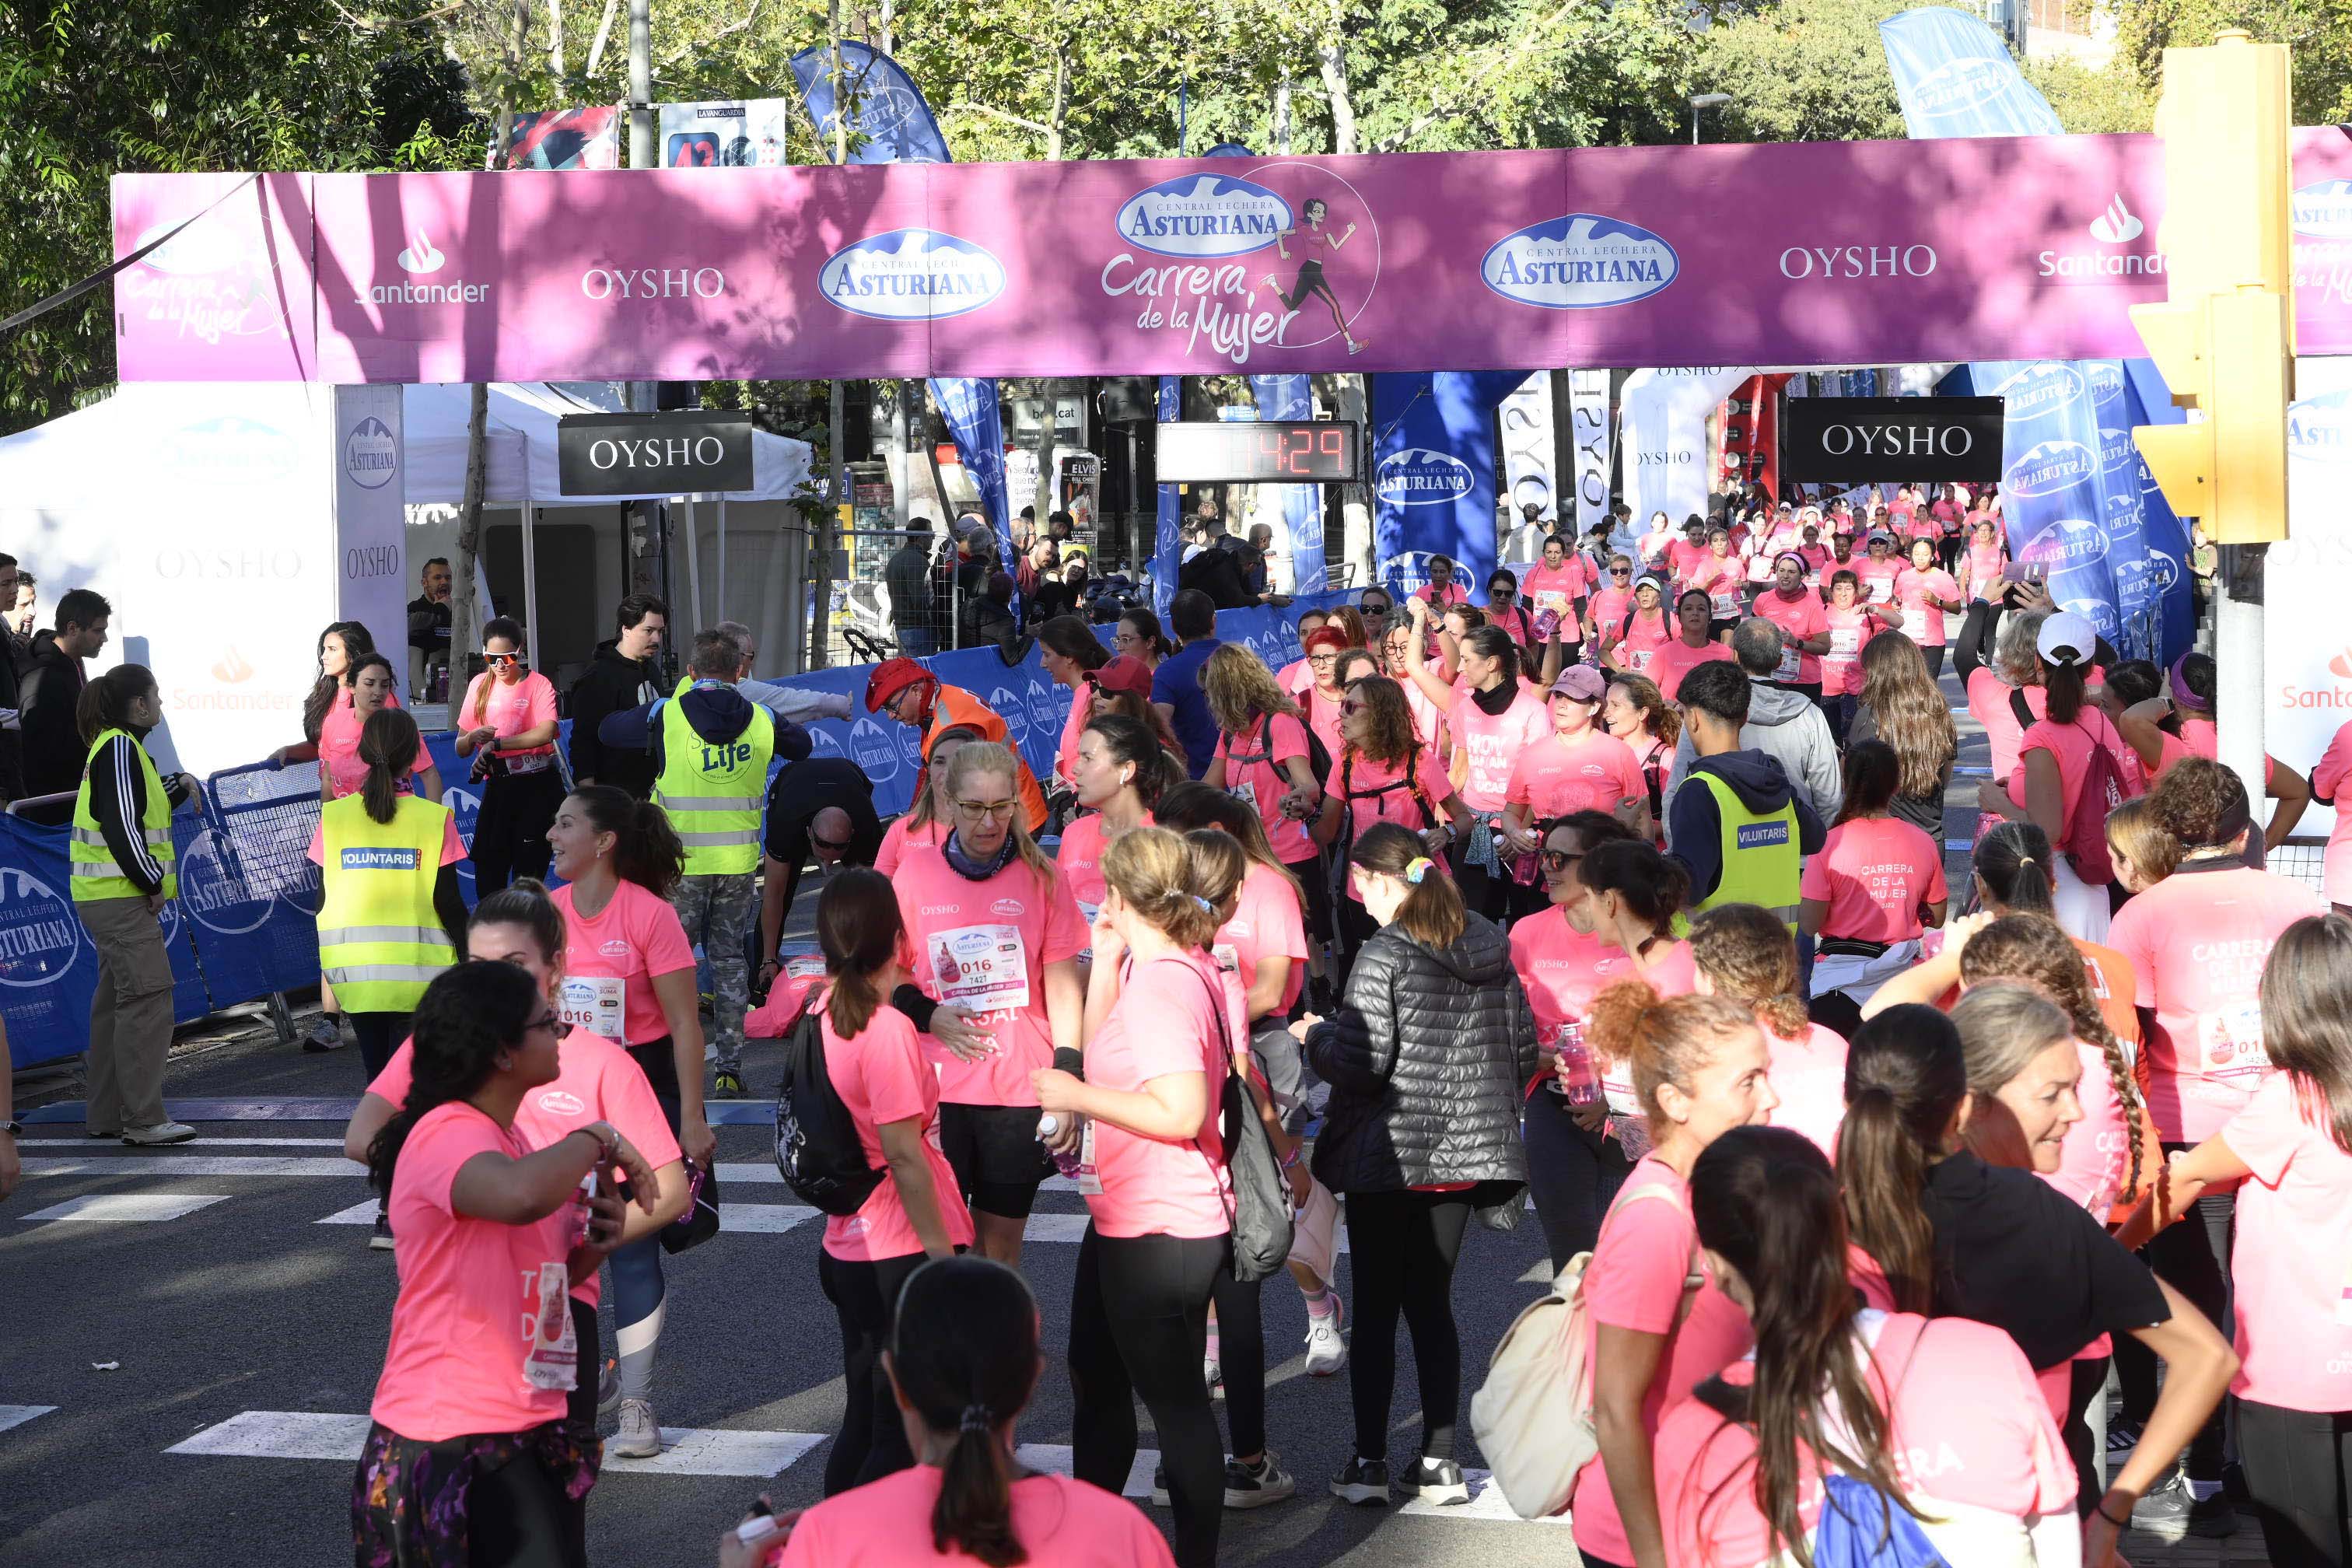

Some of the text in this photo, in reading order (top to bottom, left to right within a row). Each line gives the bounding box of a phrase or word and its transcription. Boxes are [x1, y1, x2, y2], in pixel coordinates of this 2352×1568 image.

[1157, 201, 1274, 212] CENTRAL LECHERA
[1130, 205, 1278, 236] ASTURIANA
[1527, 246, 1657, 257] CENTRAL LECHERA
[1780, 244, 1937, 280] OYSHO
[862, 261, 919, 269] CENTRAL
[1101, 254, 1246, 296] Carrera
[1496, 250, 1664, 285] ASTURIANA
[582, 267, 725, 300] OYSHO
[834, 261, 990, 298] ASTURIANA
[354, 280, 489, 304] Santander
[1137, 292, 1300, 364] de la Mujer
[1822, 425, 1972, 457] OYSHO
[349, 443, 395, 471] ASTURIANA
[590, 436, 724, 471] OYSHO
[1633, 450, 1691, 467] OYSHO
[1072, 464, 1096, 474] ELVIS
[1378, 471, 1467, 493] ASTURIANA
[155, 548, 304, 579] OYSHO
[347, 544, 398, 579] OYSHO
[173, 688, 295, 711] Santander
[702, 740, 751, 772] Life
[854, 744, 897, 768] ASTURIANA
[1738, 826, 1787, 843] VOLUNTARIS
[342, 853, 414, 865] VOLUNTARIS
[1861, 863, 1913, 875] CARRERA
[1872, 877, 1905, 887] DE LA
[1870, 889, 1908, 898] MUJER
[27, 903, 60, 915] LECHERA
[921, 905, 960, 915] OYSHO
[956, 941, 990, 951] ASTURIANA
[961, 959, 992, 974] 016
[1535, 960, 1568, 969] OYSHO
[565, 1010, 593, 1022] 016
